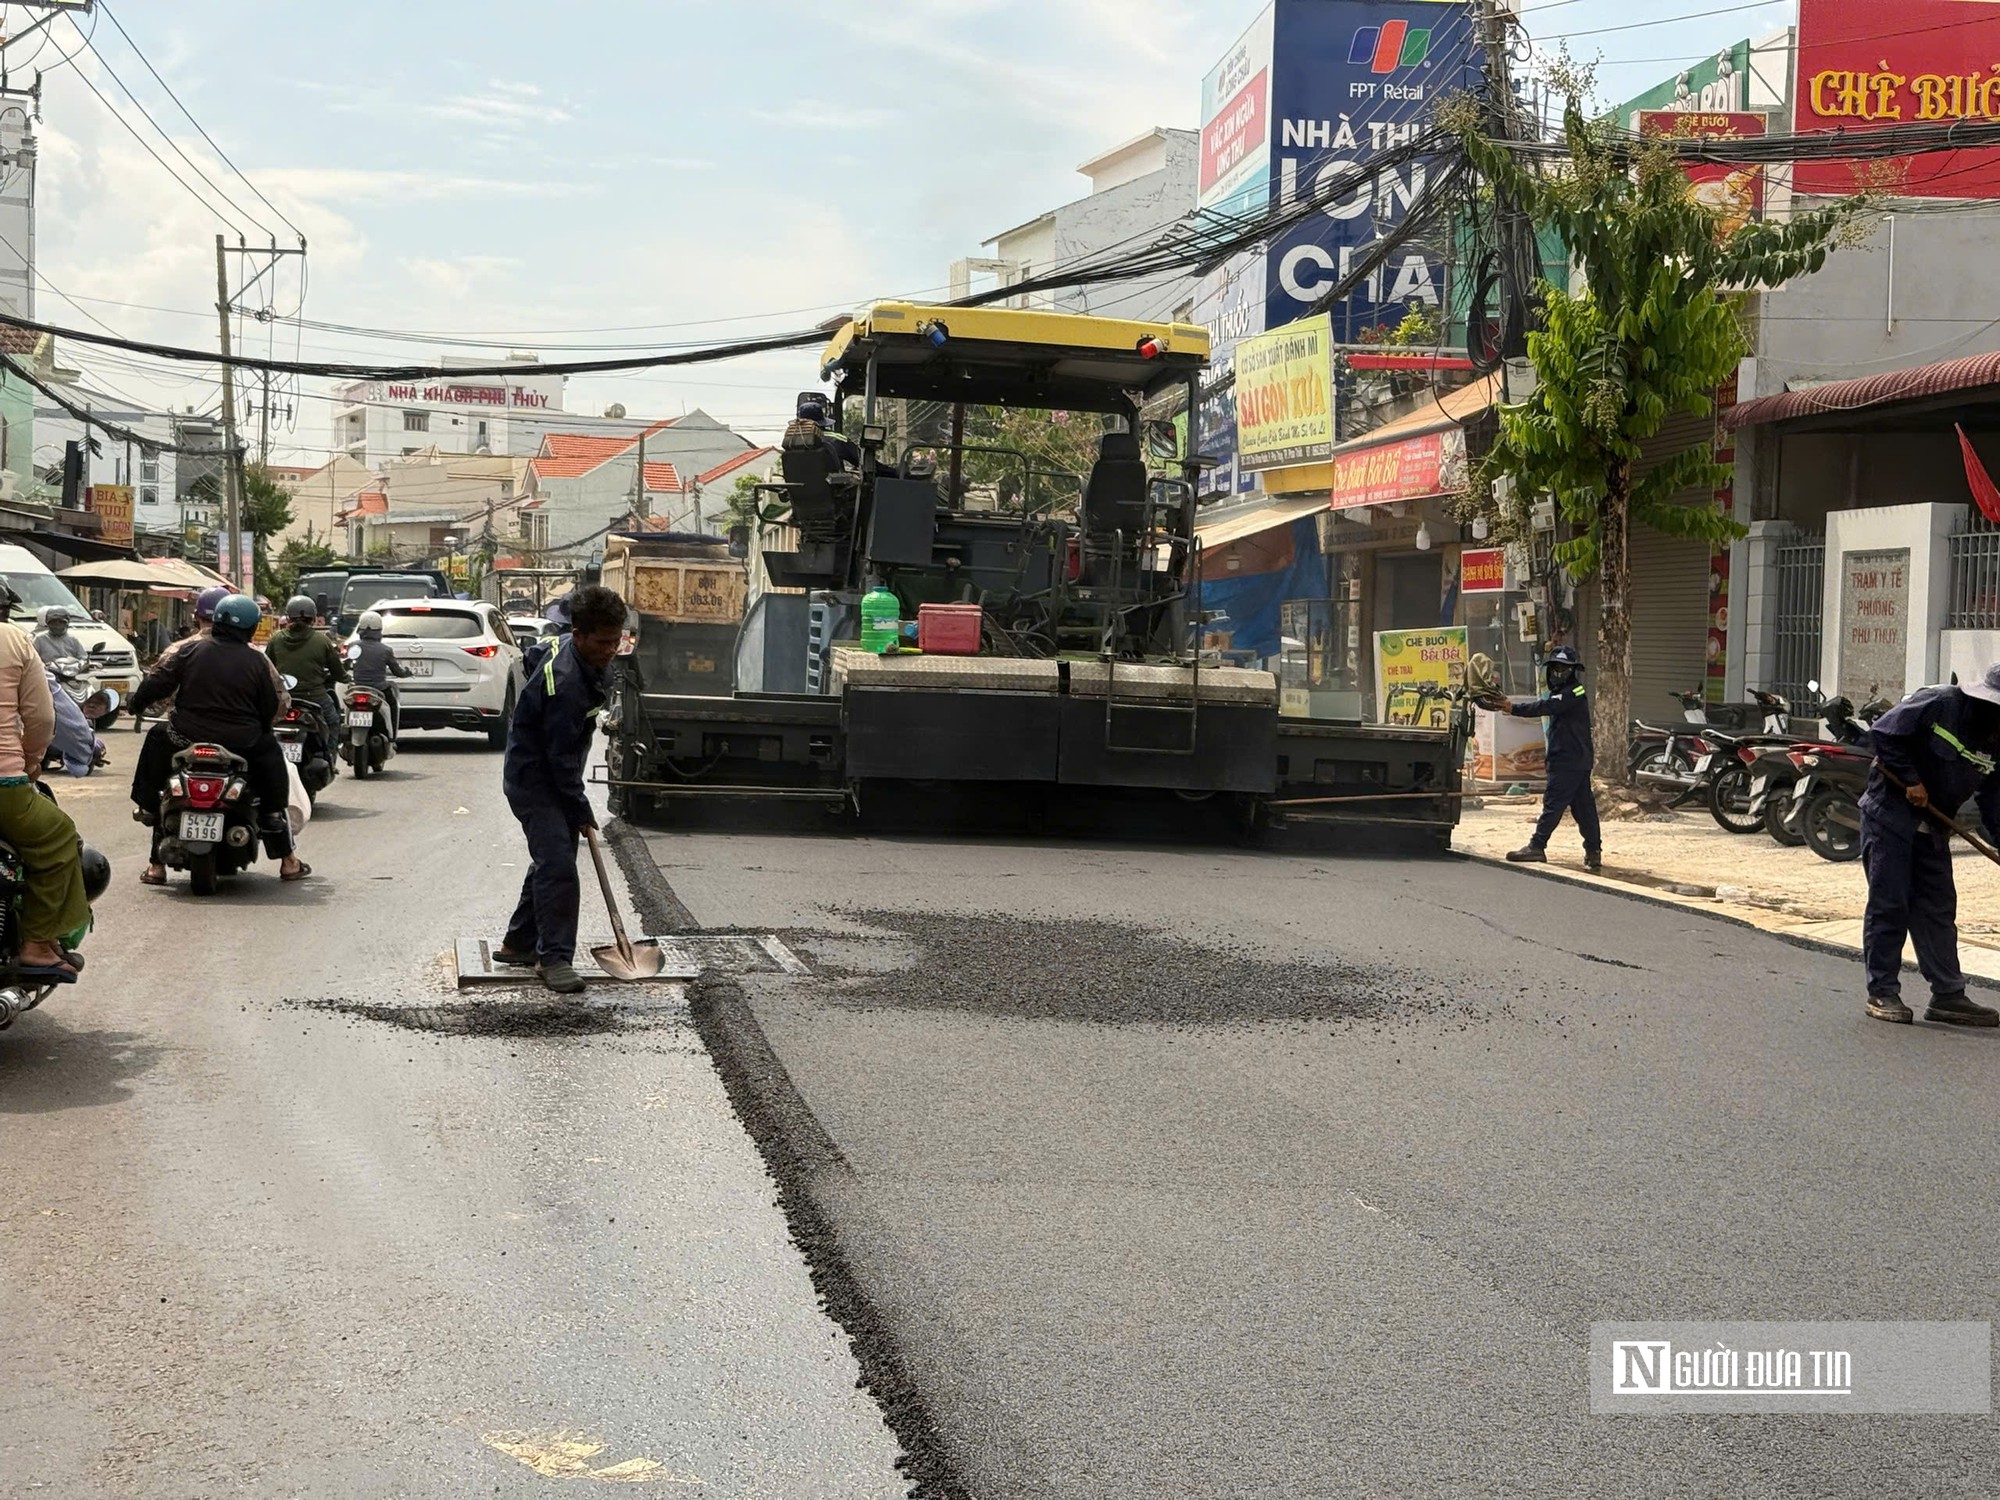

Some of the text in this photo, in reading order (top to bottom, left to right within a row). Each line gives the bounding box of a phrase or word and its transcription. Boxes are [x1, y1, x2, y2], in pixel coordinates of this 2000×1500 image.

[1350, 83, 1423, 100] FPT Retail
[1809, 59, 1905, 120] CHÈ
[1282, 113, 1357, 149] NHÀ
[1285, 337, 1306, 362] BÁNH
[1308, 330, 1318, 356] MÌ
[1240, 379, 1260, 429] SÀI
[1262, 372, 1289, 424] GÒN
[96, 490, 117, 502] BIA
[1851, 572, 1878, 591] TRẠM
[1881, 572, 1887, 588] Y
[187, 815, 218, 827] 54-Z7
[186, 827, 217, 840] 6196
